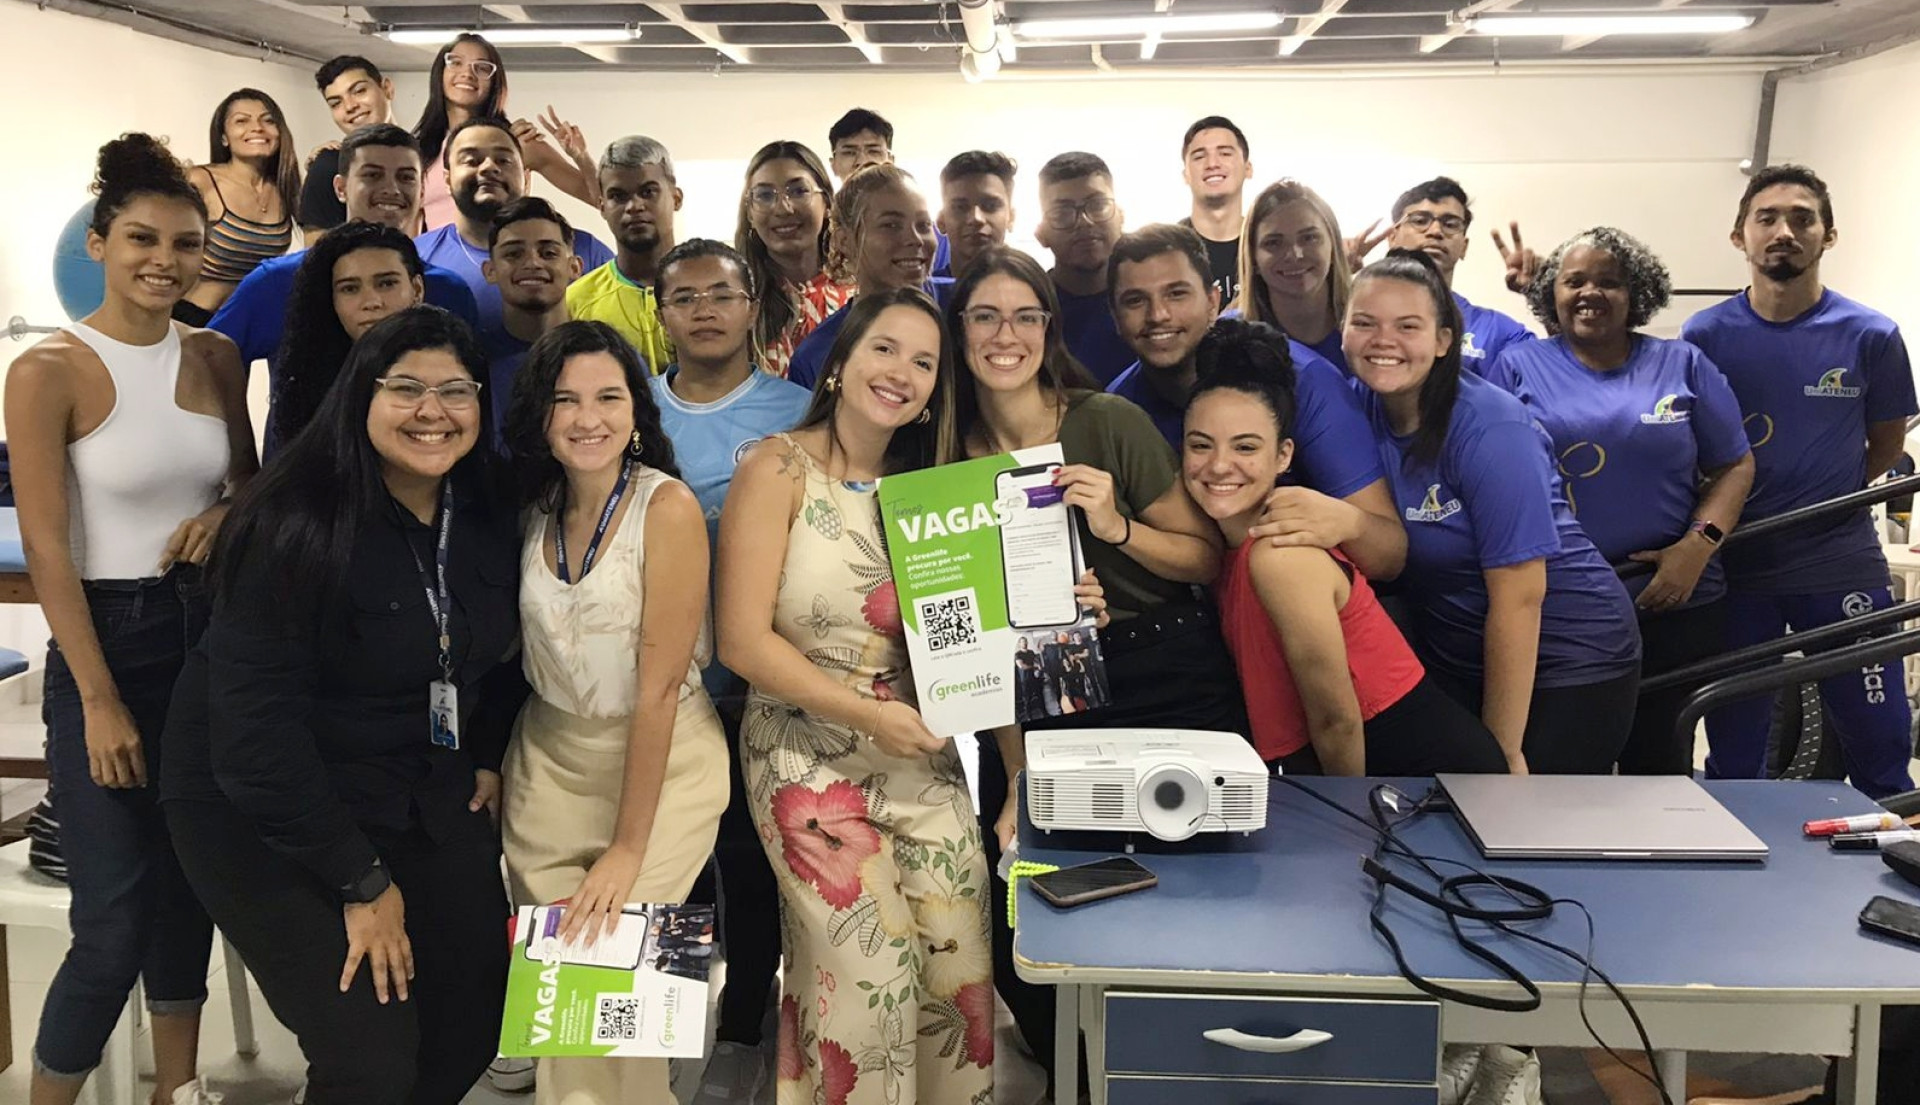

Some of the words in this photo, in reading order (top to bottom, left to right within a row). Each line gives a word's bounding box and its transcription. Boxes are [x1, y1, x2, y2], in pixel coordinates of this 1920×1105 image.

[898, 502, 1013, 543] VAGAS
[907, 561, 938, 573] procura
[938, 557, 952, 567] por
[936, 673, 1001, 701] greenlife
[530, 951, 562, 1046] VAGAS
[664, 986, 676, 1042] greenlife
